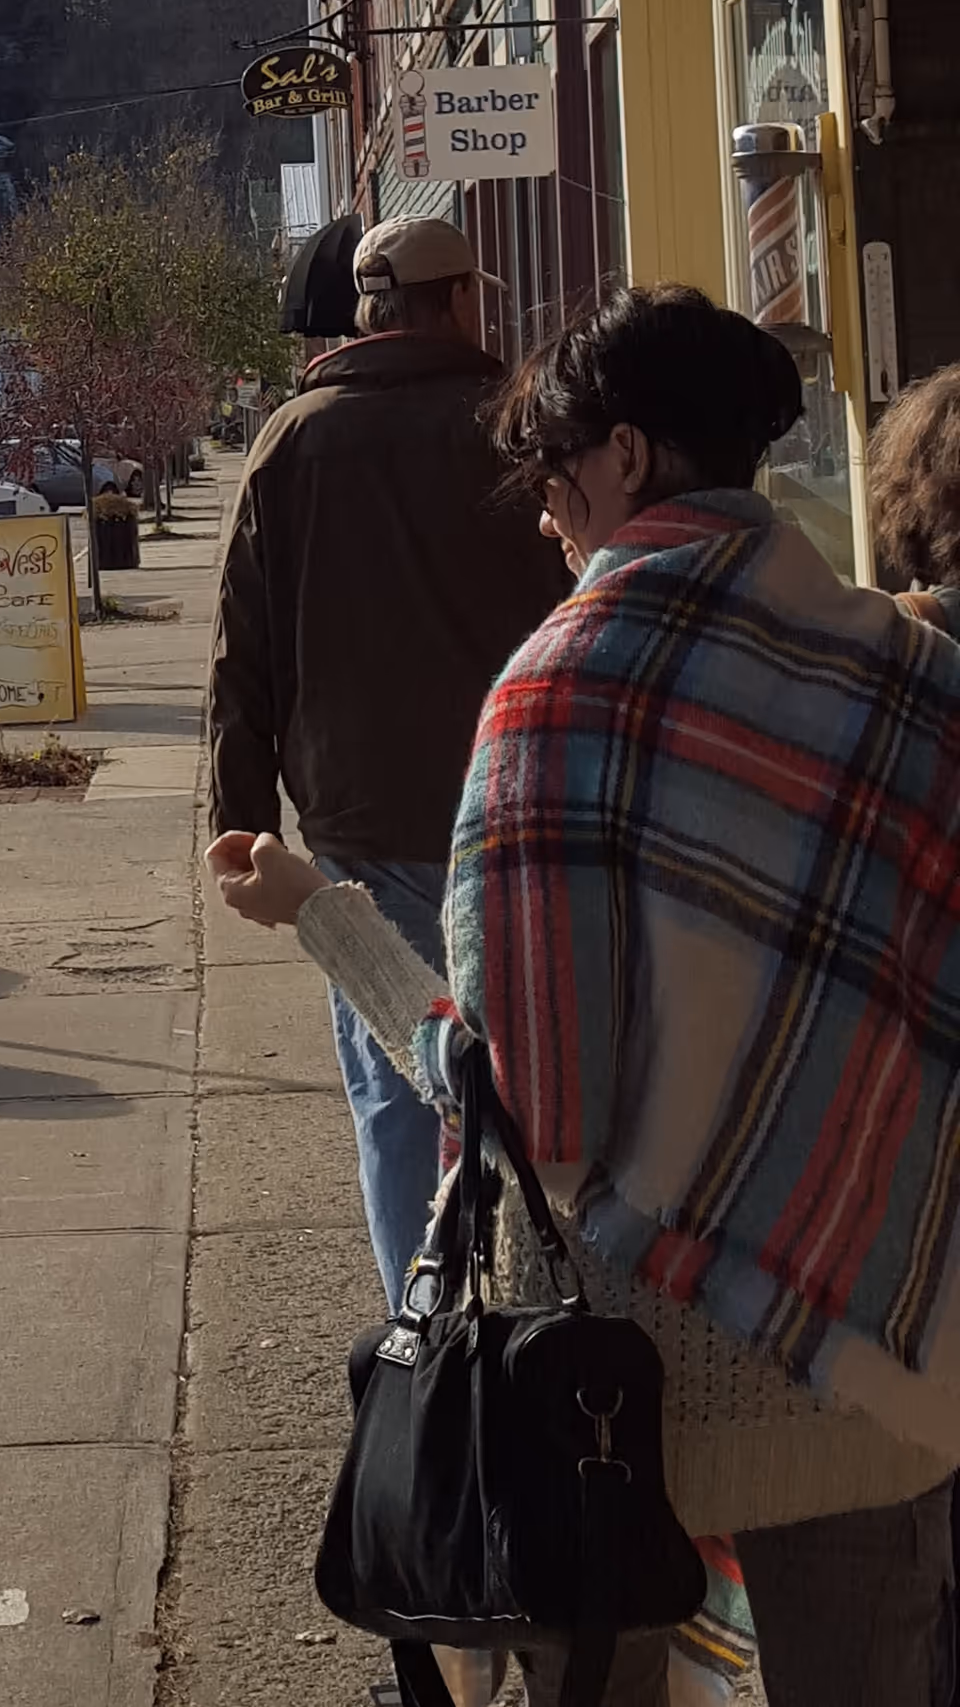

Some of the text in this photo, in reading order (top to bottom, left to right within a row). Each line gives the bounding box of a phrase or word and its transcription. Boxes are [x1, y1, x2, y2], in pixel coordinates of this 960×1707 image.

[260, 53, 339, 90] Sal's
[252, 95, 283, 115] Bar
[287, 90, 303, 105] &
[308, 89, 348, 106] Grill
[434, 89, 540, 115] Barber
[450, 128, 527, 156] Shop
